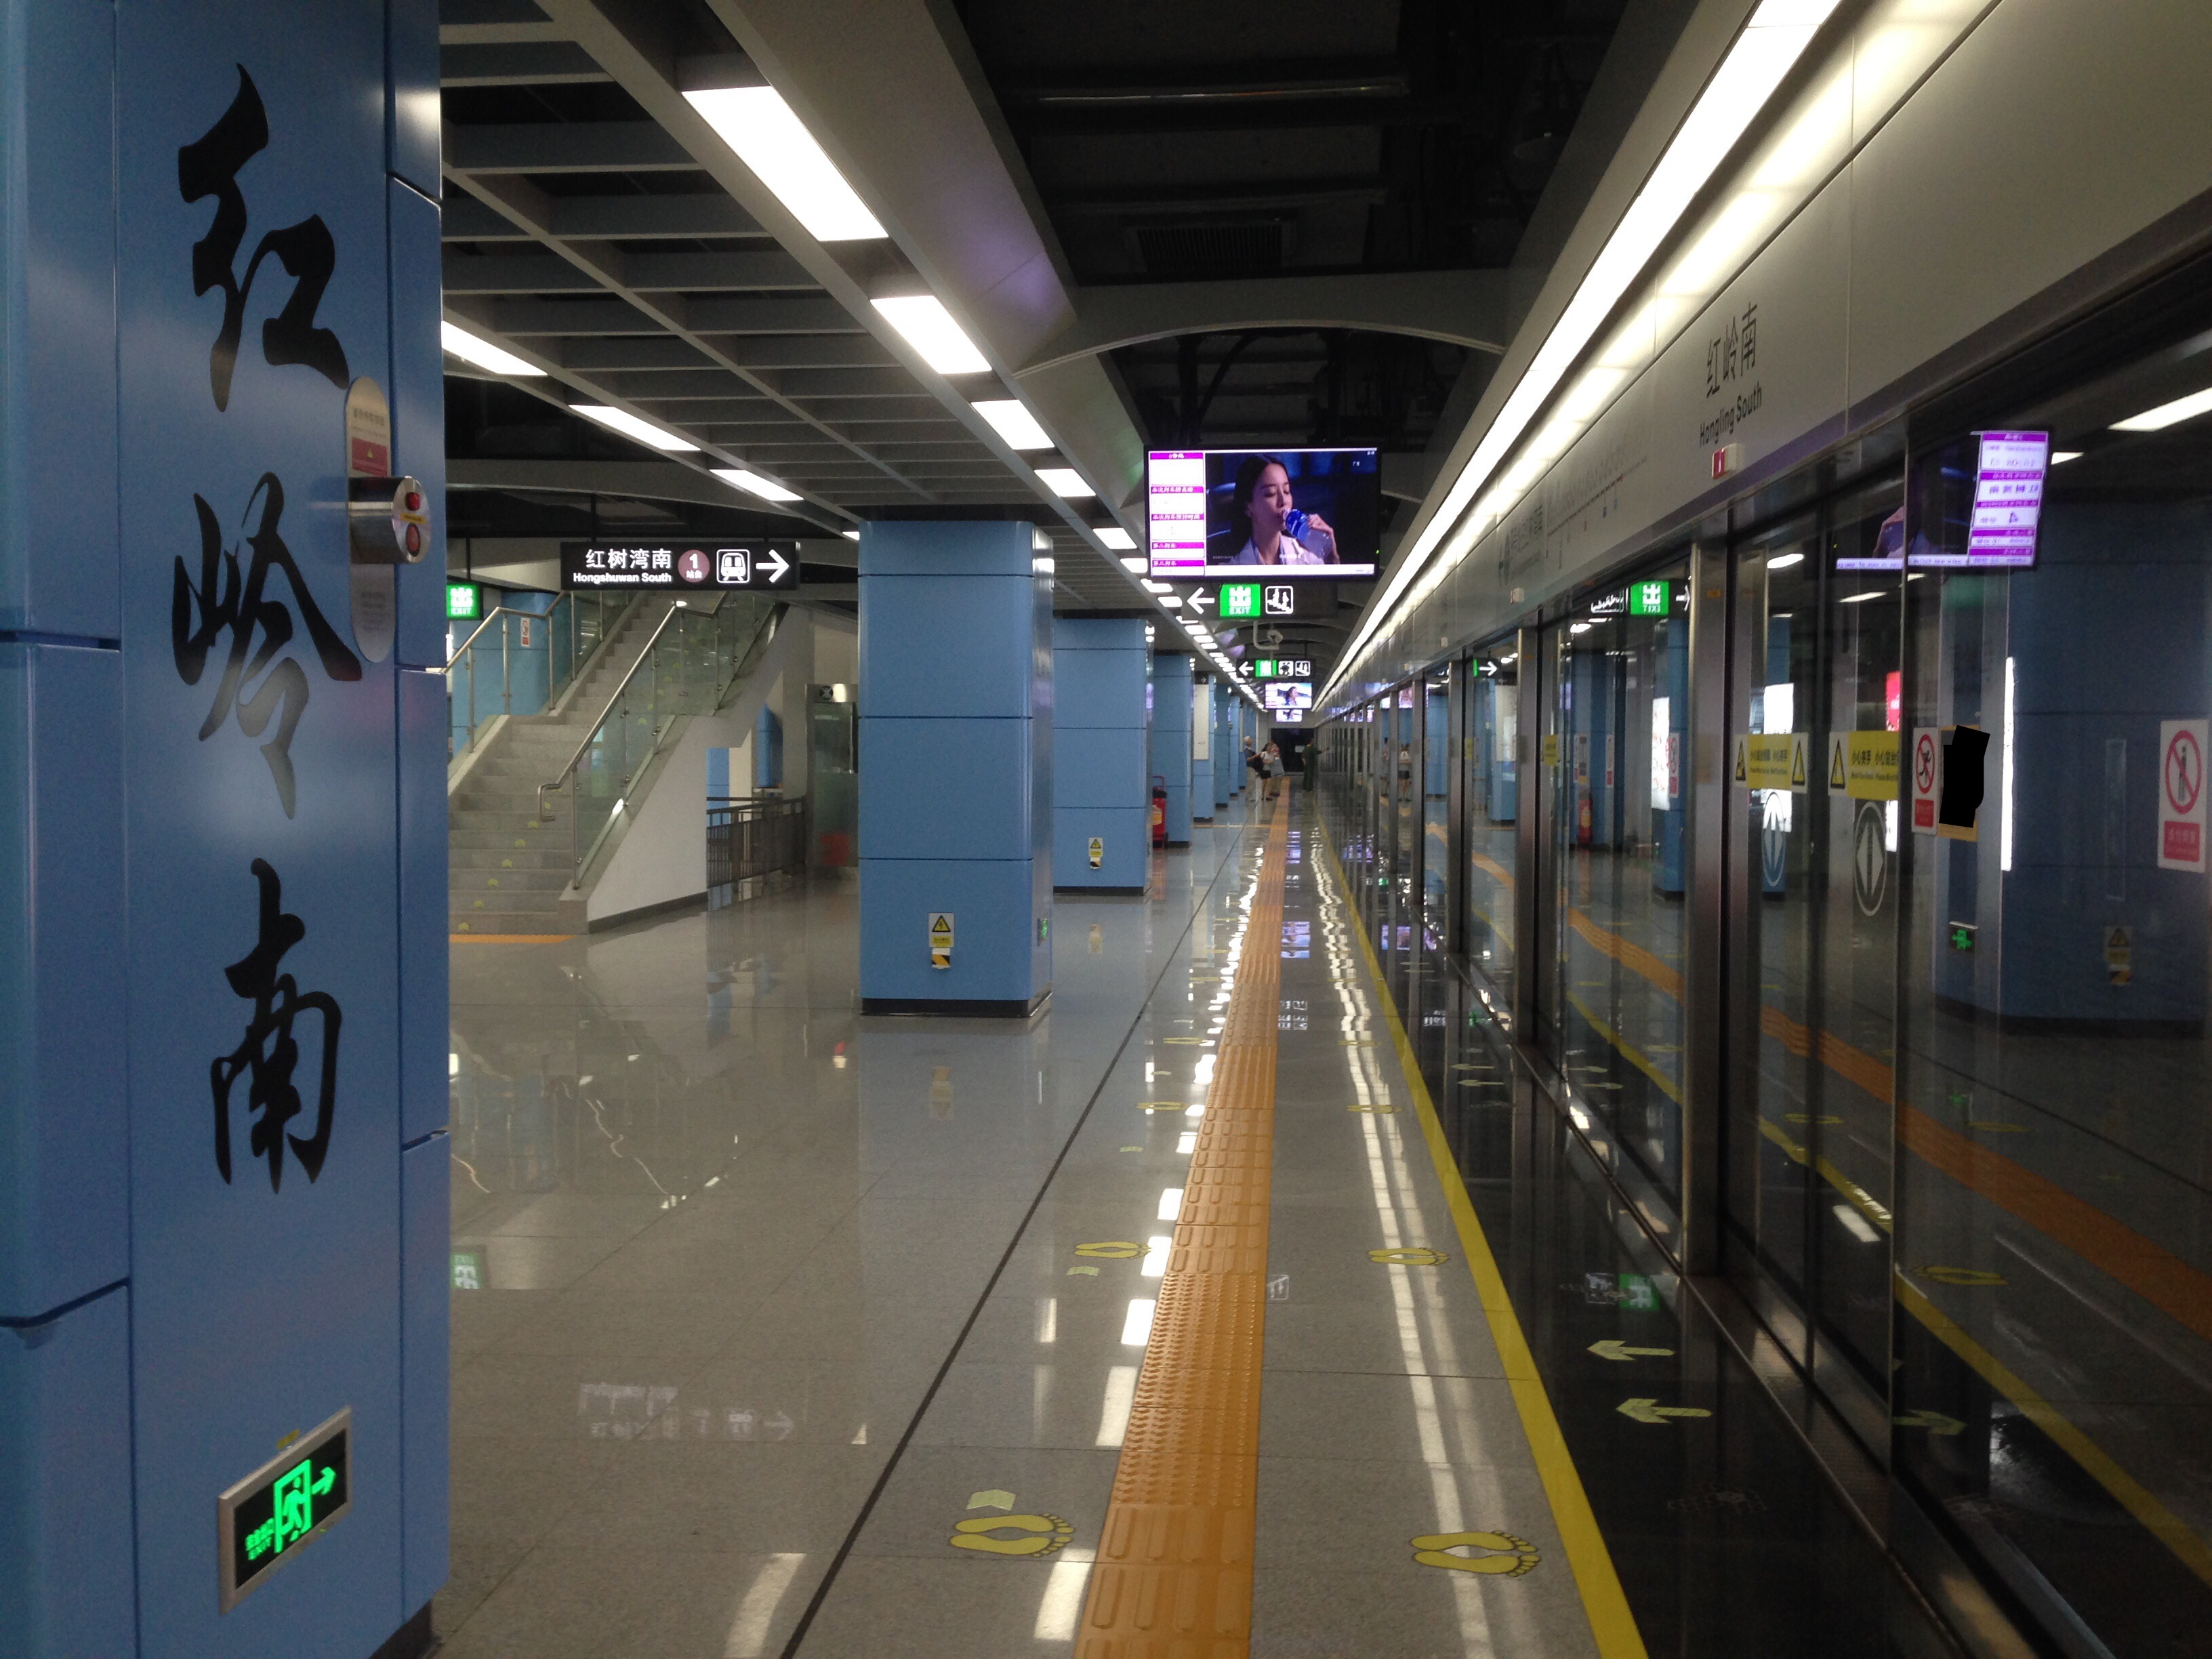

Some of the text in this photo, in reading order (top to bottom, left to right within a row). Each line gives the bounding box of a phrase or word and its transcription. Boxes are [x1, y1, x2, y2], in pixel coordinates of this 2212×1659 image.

[1705, 301, 1758, 398] 红岭南
[1699, 380, 1762, 447] Hongling South
[585, 548, 672, 569] 红树湾南
[689, 553, 699, 569] 1
[573, 572, 672, 583] Hongshuwan South
[1229, 607, 1251, 615] EXIT
